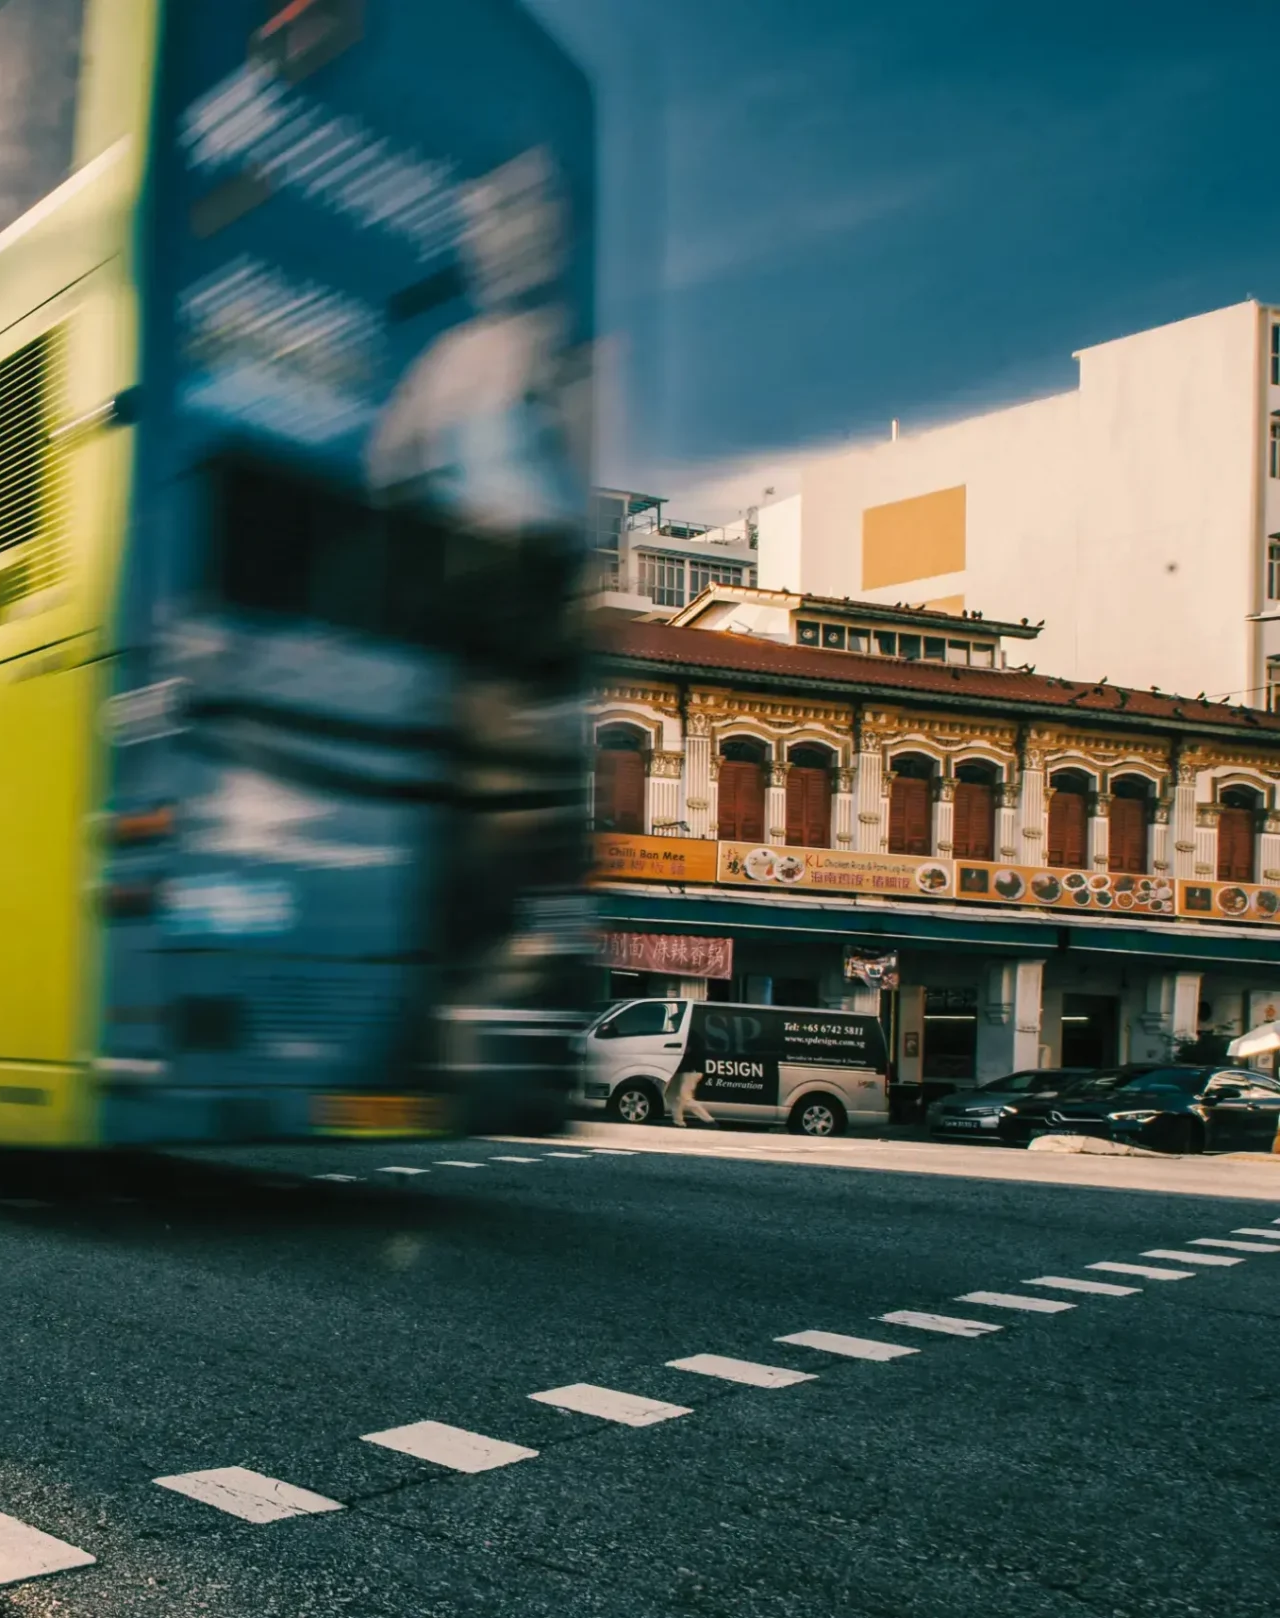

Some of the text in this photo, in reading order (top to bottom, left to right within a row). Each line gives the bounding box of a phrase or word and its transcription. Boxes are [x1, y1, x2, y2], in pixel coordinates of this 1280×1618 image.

[609, 847, 685, 861] Chilli Ban Mee
[705, 1014, 761, 1054] SP
[784, 1022, 864, 1036] Tel: +65 6742 5811
[784, 1036, 865, 1049] www.spdesign.com.sg
[705, 1059, 763, 1077] DESIGN
[705, 1078, 763, 1090] & Renovation
